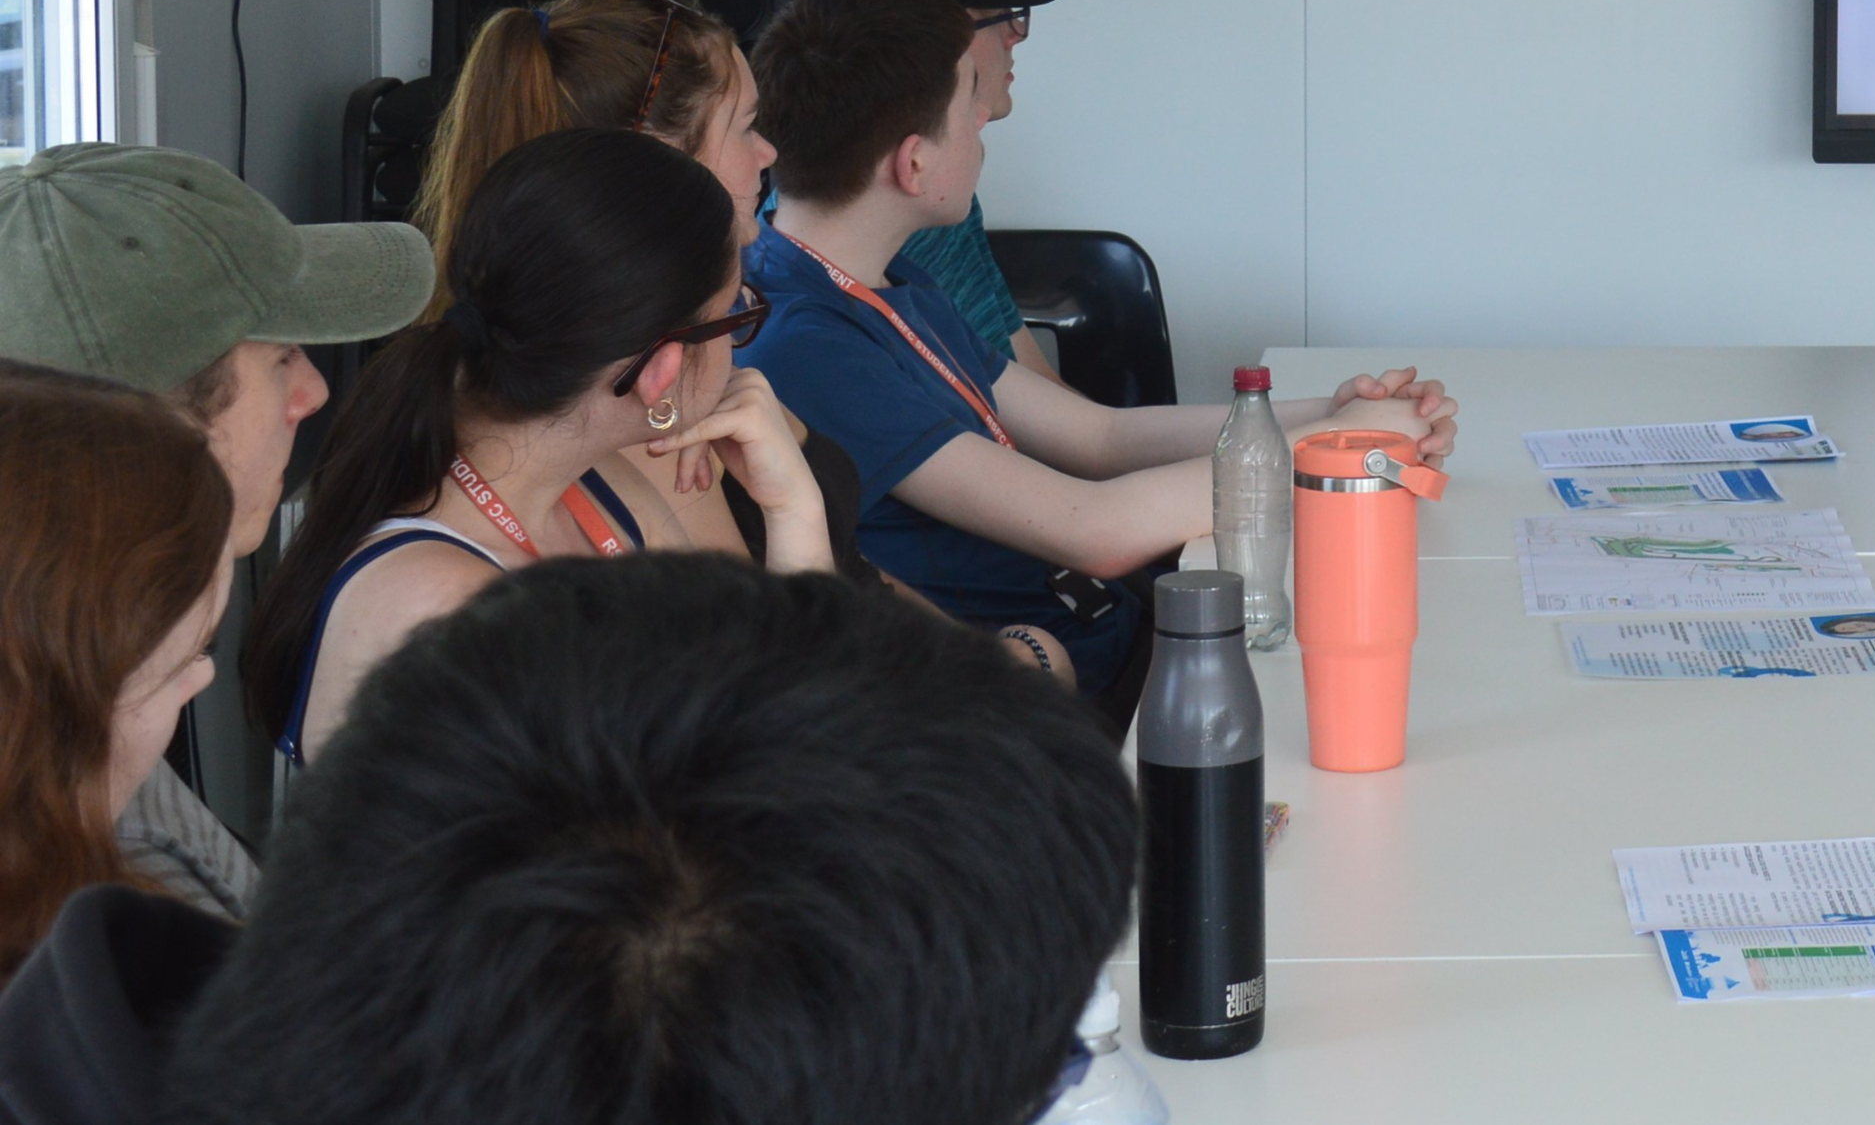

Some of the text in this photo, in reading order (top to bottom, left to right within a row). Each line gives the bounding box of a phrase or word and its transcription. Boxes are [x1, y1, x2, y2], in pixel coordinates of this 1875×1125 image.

[890, 311, 958, 385] RSFC STUDENT
[985, 414, 1007, 444] RSFC
[488, 503, 526, 543] RSFC
